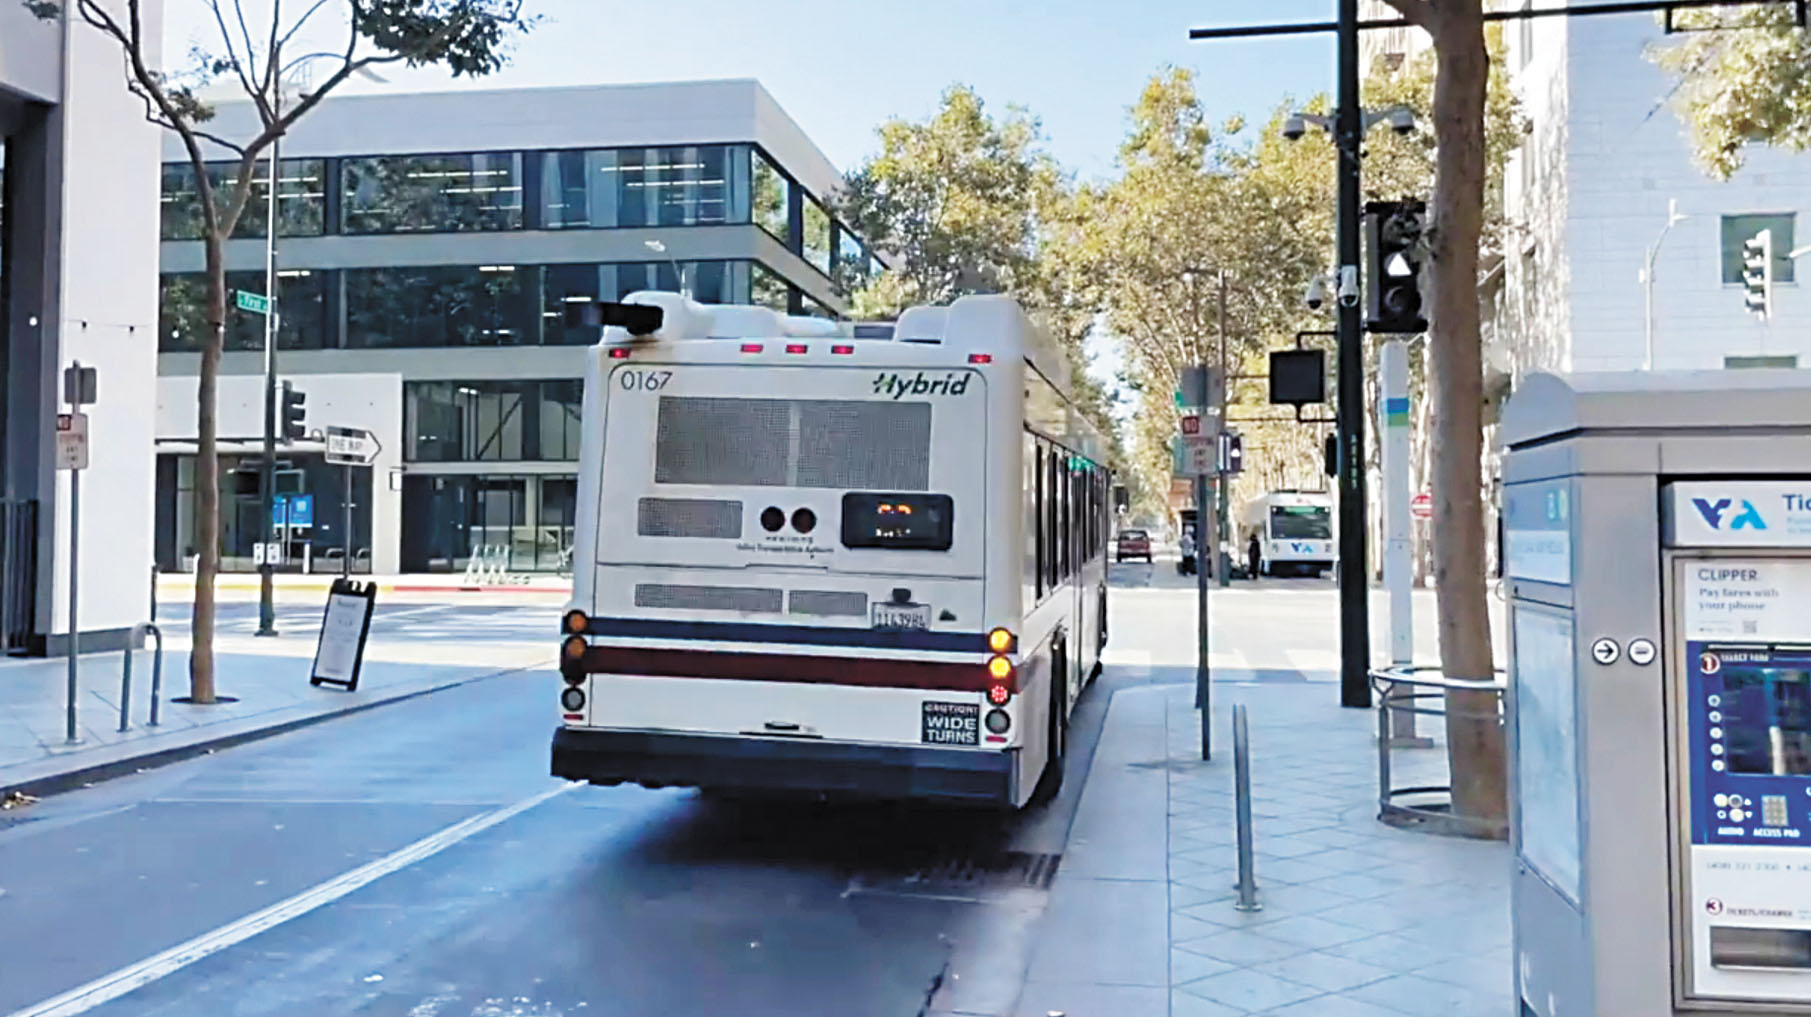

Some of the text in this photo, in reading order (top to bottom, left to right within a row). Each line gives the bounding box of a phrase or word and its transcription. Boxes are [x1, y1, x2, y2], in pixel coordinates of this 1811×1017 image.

[621, 371, 673, 390] 0167
[873, 372, 971, 400] Hybrid
[1698, 568, 1758, 581] CLIPPER
[1699, 588, 1779, 599] Pay fares with
[1699, 601, 1765, 612] your phone
[927, 716, 977, 730] WIDE
[927, 730, 977, 744] TURNS
[1717, 826, 1745, 836] AUDIO
[1753, 827, 1782, 838] ACCESS
